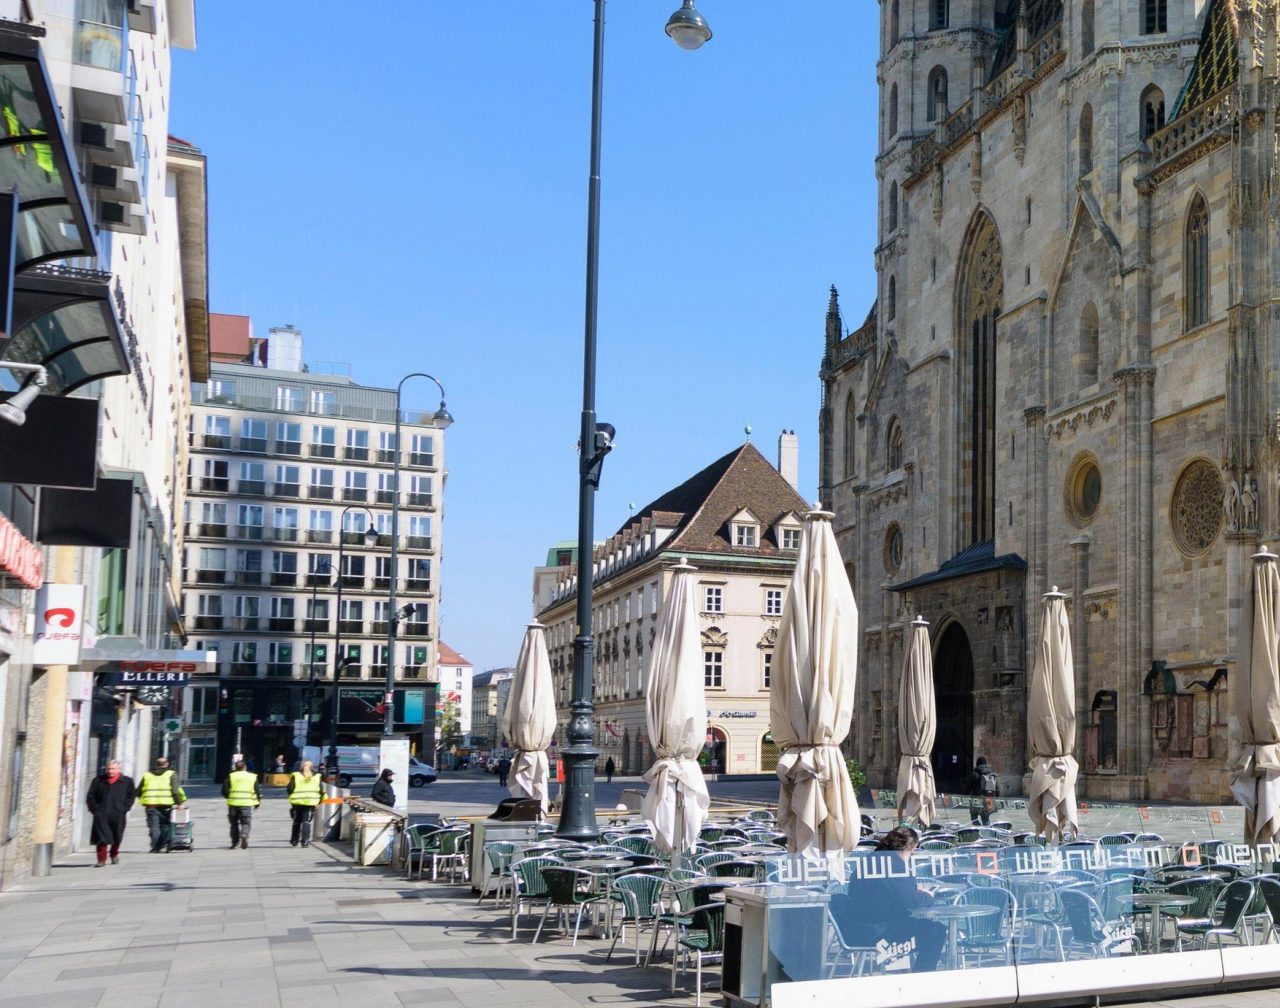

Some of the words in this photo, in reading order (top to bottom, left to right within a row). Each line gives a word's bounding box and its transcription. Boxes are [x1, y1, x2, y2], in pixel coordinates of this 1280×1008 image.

[37, 632, 81, 641] ruefa
[119, 661, 197, 672] ruefa
[777, 852, 954, 882] weinwurm
[1016, 848, 1164, 874] weinwurm
[875, 937, 917, 965] Stiegl
[1101, 924, 1137, 952] Stiegl
